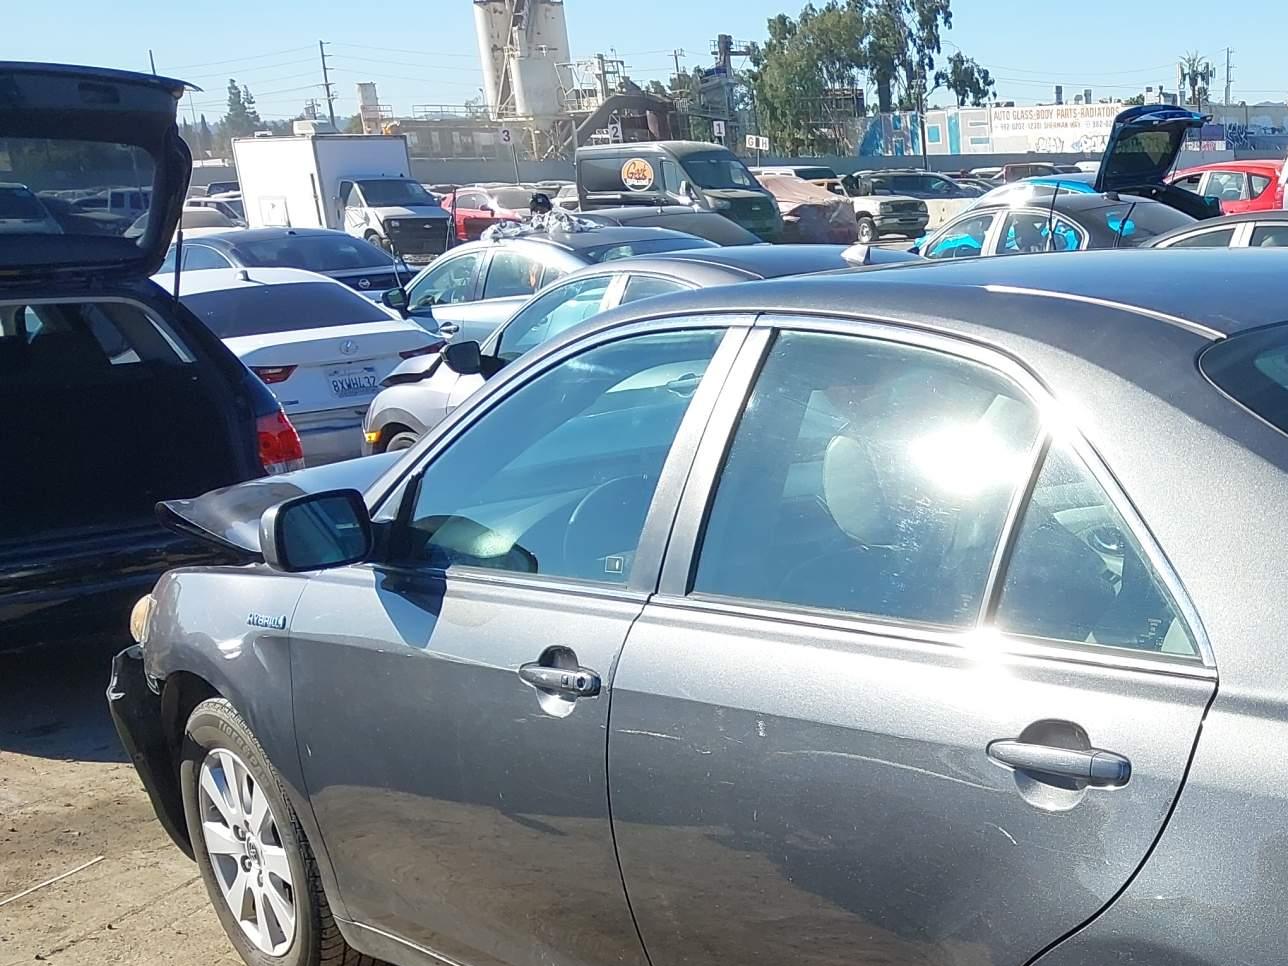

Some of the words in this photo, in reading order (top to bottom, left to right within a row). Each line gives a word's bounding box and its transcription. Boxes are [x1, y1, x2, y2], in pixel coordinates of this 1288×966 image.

[993, 110, 1010, 121] AUTO
[611, 126, 620, 138] 2
[716, 124, 723, 135] 1
[502, 129, 511, 142] 3
